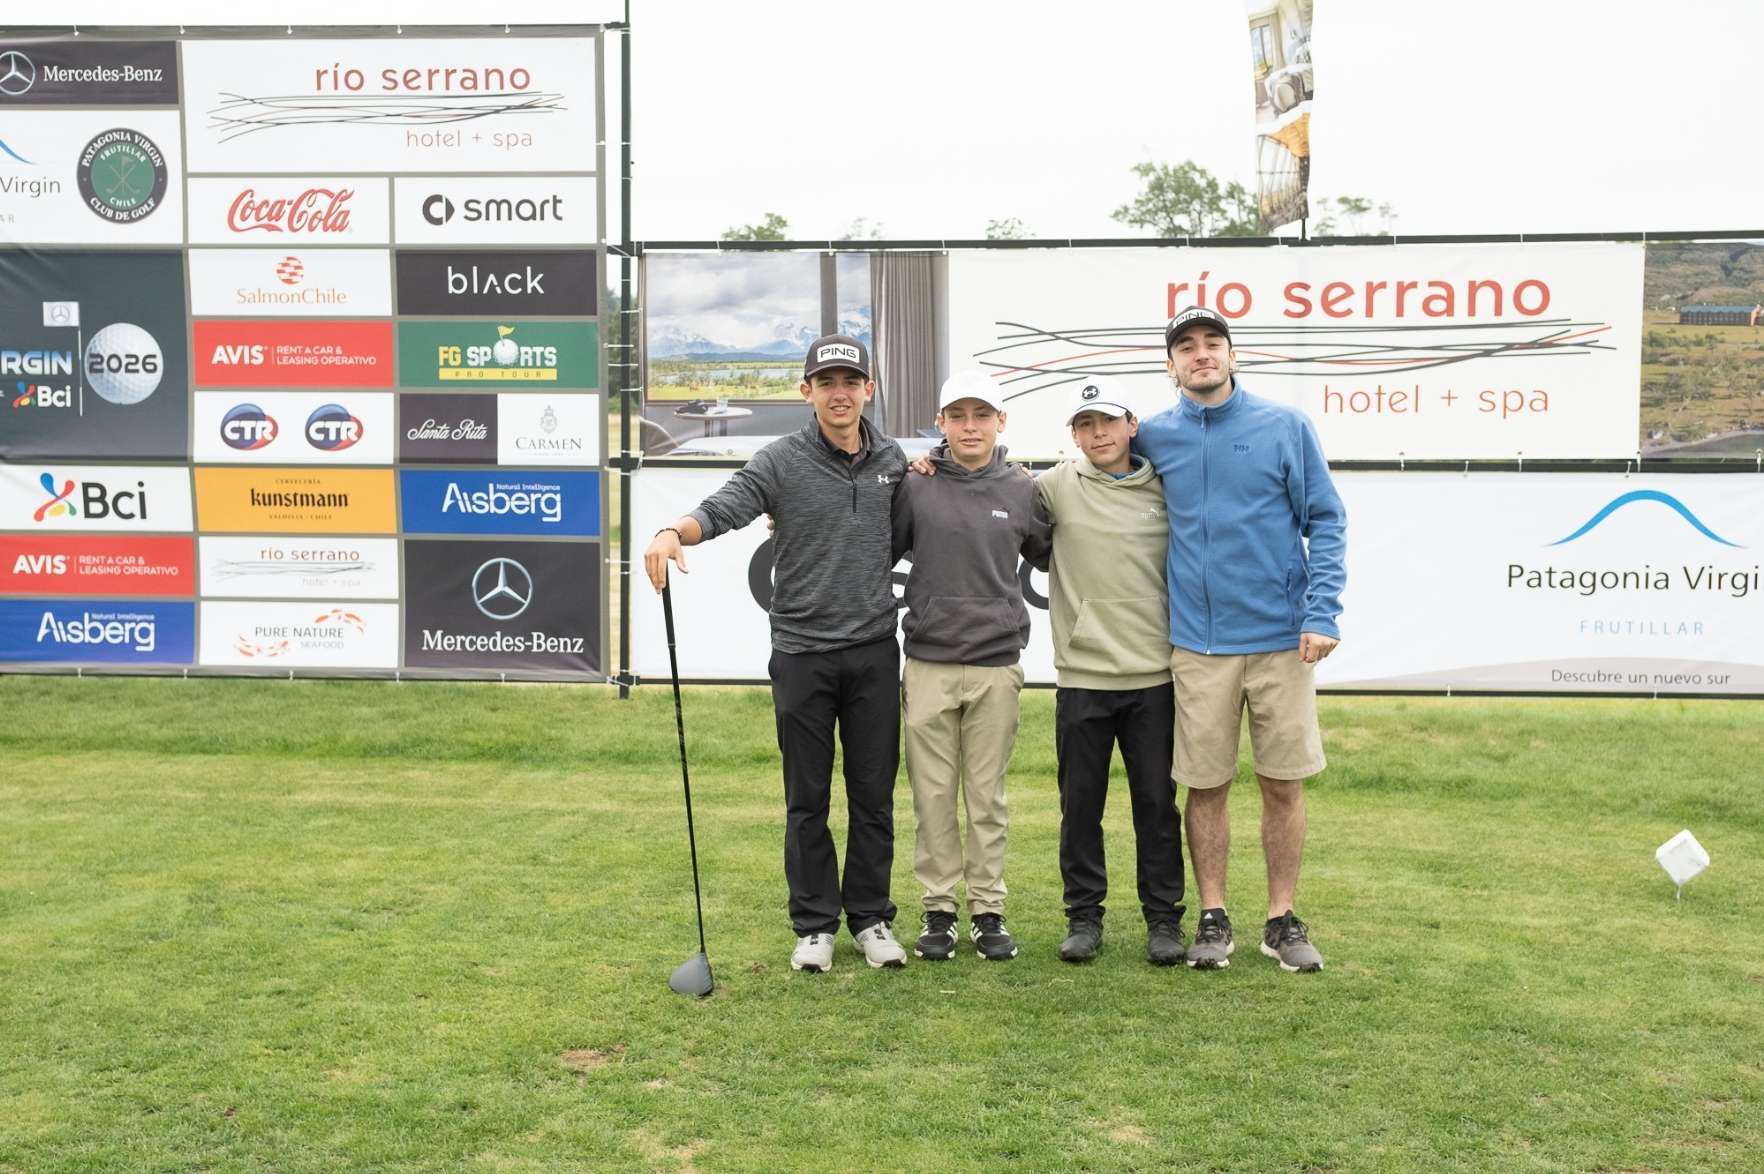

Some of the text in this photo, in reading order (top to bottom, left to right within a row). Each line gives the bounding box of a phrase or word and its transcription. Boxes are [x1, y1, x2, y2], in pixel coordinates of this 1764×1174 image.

[43, 65, 163, 82] Mercedes-Benz
[315, 62, 531, 91] río serrano
[81, 131, 163, 168] PATAGONIA VIRGIN
[406, 129, 462, 148] hotel
[492, 132, 533, 151] spa
[100, 145, 146, 162] FRUTILLAR
[0, 176, 61, 198] Virgin
[90, 196, 155, 221] CLUB DE GOLF
[110, 197, 136, 207] CHILE
[227, 188, 354, 232] Coca-Cola
[463, 195, 563, 221] smart
[447, 265, 545, 294] black
[236, 287, 347, 304] SalmonChile
[1167, 271, 1551, 319] río serrano
[211, 345, 265, 365] AVIS
[276, 346, 343, 355] RENT A CAR &
[276, 356, 377, 366] LEASING OPERATIVO
[438, 346, 462, 367] FG
[820, 347, 857, 359] PING
[1, 351, 73, 375] RGIN
[89, 354, 158, 374] 2026
[37, 385, 71, 407] Bci
[1324, 384, 1419, 414] hotel
[1479, 390, 1549, 419] spa
[224, 420, 274, 441] CTR
[308, 420, 358, 441] CTR
[407, 418, 488, 440] Santa Rita
[515, 437, 582, 450] CARMEN
[250, 488, 349, 508] kunstmann
[496, 483, 561, 492] Natural Intelligence
[82, 481, 147, 520] Bci
[441, 482, 562, 522] Aisberg
[13, 554, 67, 575] AVIS
[79, 556, 145, 565] RENT A CAR &
[260, 547, 360, 561] río serrano
[79, 566, 180, 576] LEASING OPERATIVO
[1507, 564, 1670, 597] Patagonia
[36, 611, 155, 652] Aisberg
[255, 626, 344, 638] PURE NATURE
[1580, 620, 1704, 635] FRUTILLAR
[300, 640, 344, 649] SEAFOOD
[422, 629, 584, 653] Mercedes-Benz
[1551, 668, 1731, 685] Descubre un nuevo sur
